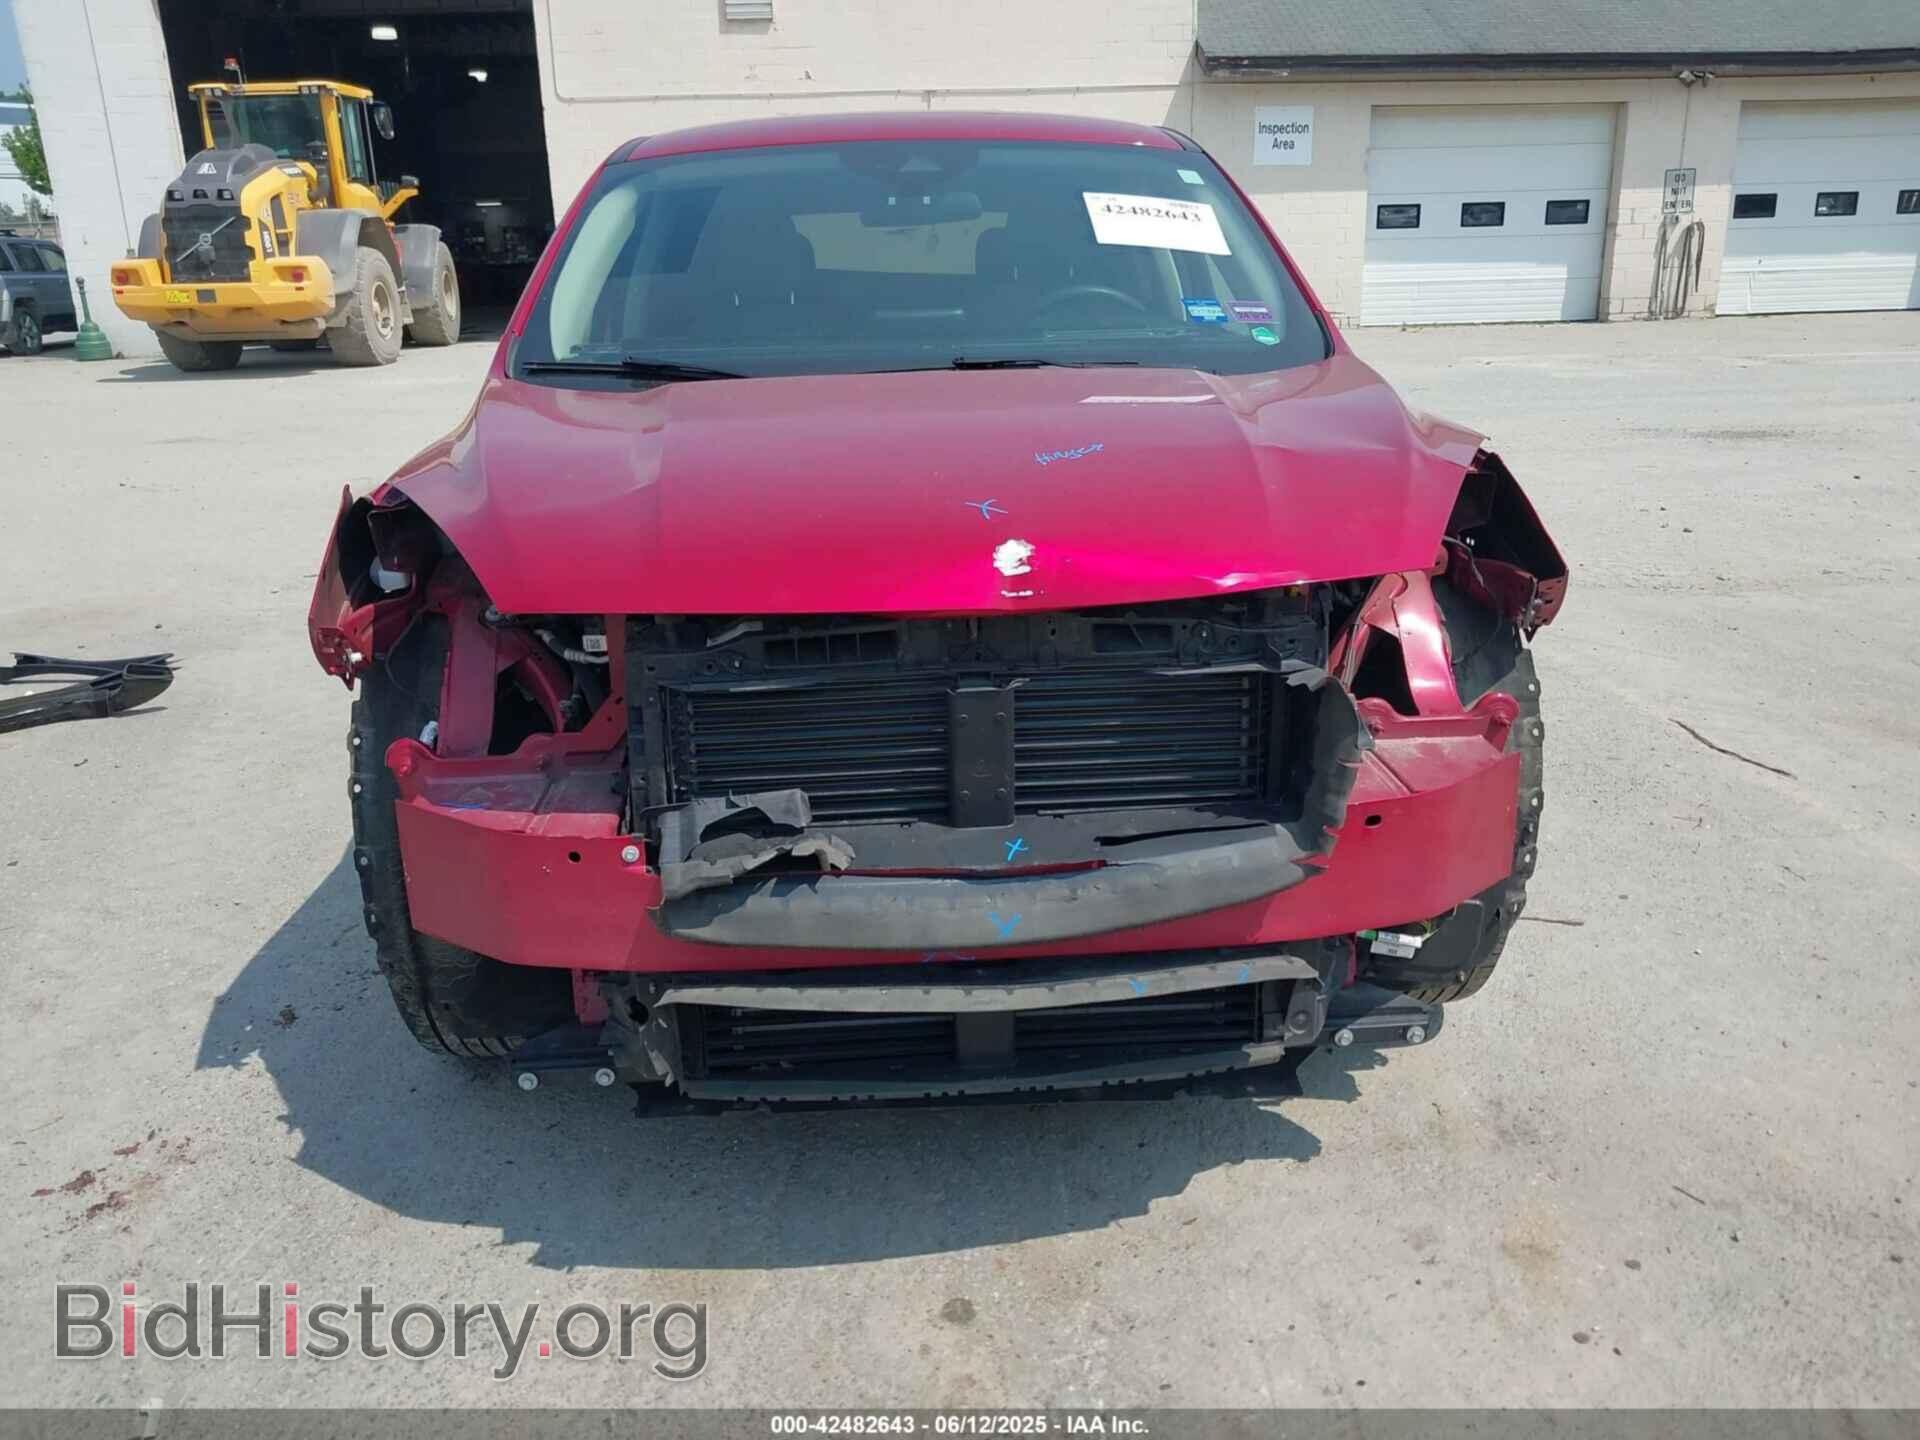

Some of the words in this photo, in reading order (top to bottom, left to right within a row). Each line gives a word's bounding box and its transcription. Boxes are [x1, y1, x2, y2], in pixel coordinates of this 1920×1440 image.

[1258, 121, 1310, 136] Inspection
[1272, 137, 1295, 150] Area
[1665, 200, 1690, 209] ENER
[1102, 203, 1201, 222] 42482643
